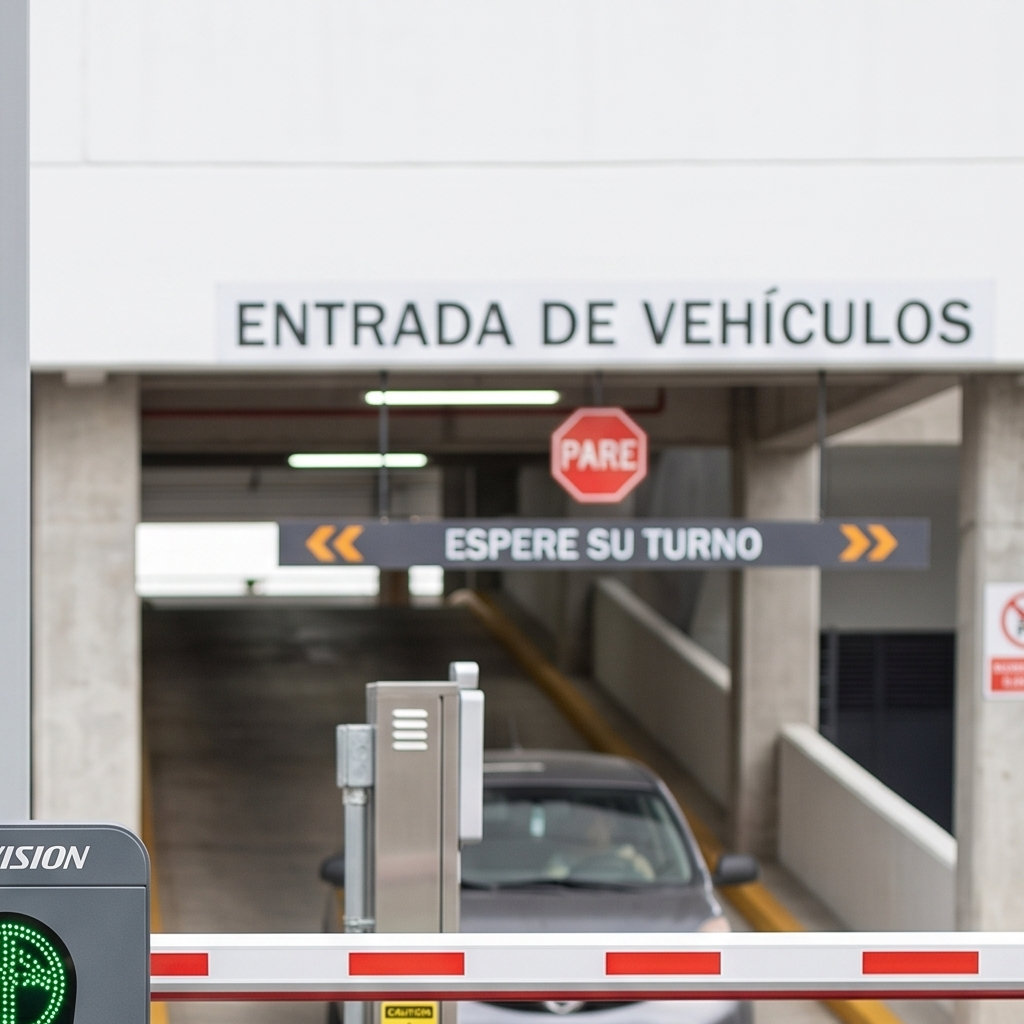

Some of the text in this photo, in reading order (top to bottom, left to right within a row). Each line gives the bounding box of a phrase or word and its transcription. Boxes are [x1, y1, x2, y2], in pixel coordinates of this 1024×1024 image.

[238, 287, 973, 347] ENTRADA DE VEHÍCULOS
[561, 438, 639, 471] PARE
[445, 527, 763, 562] ESPERE SU TURNO
